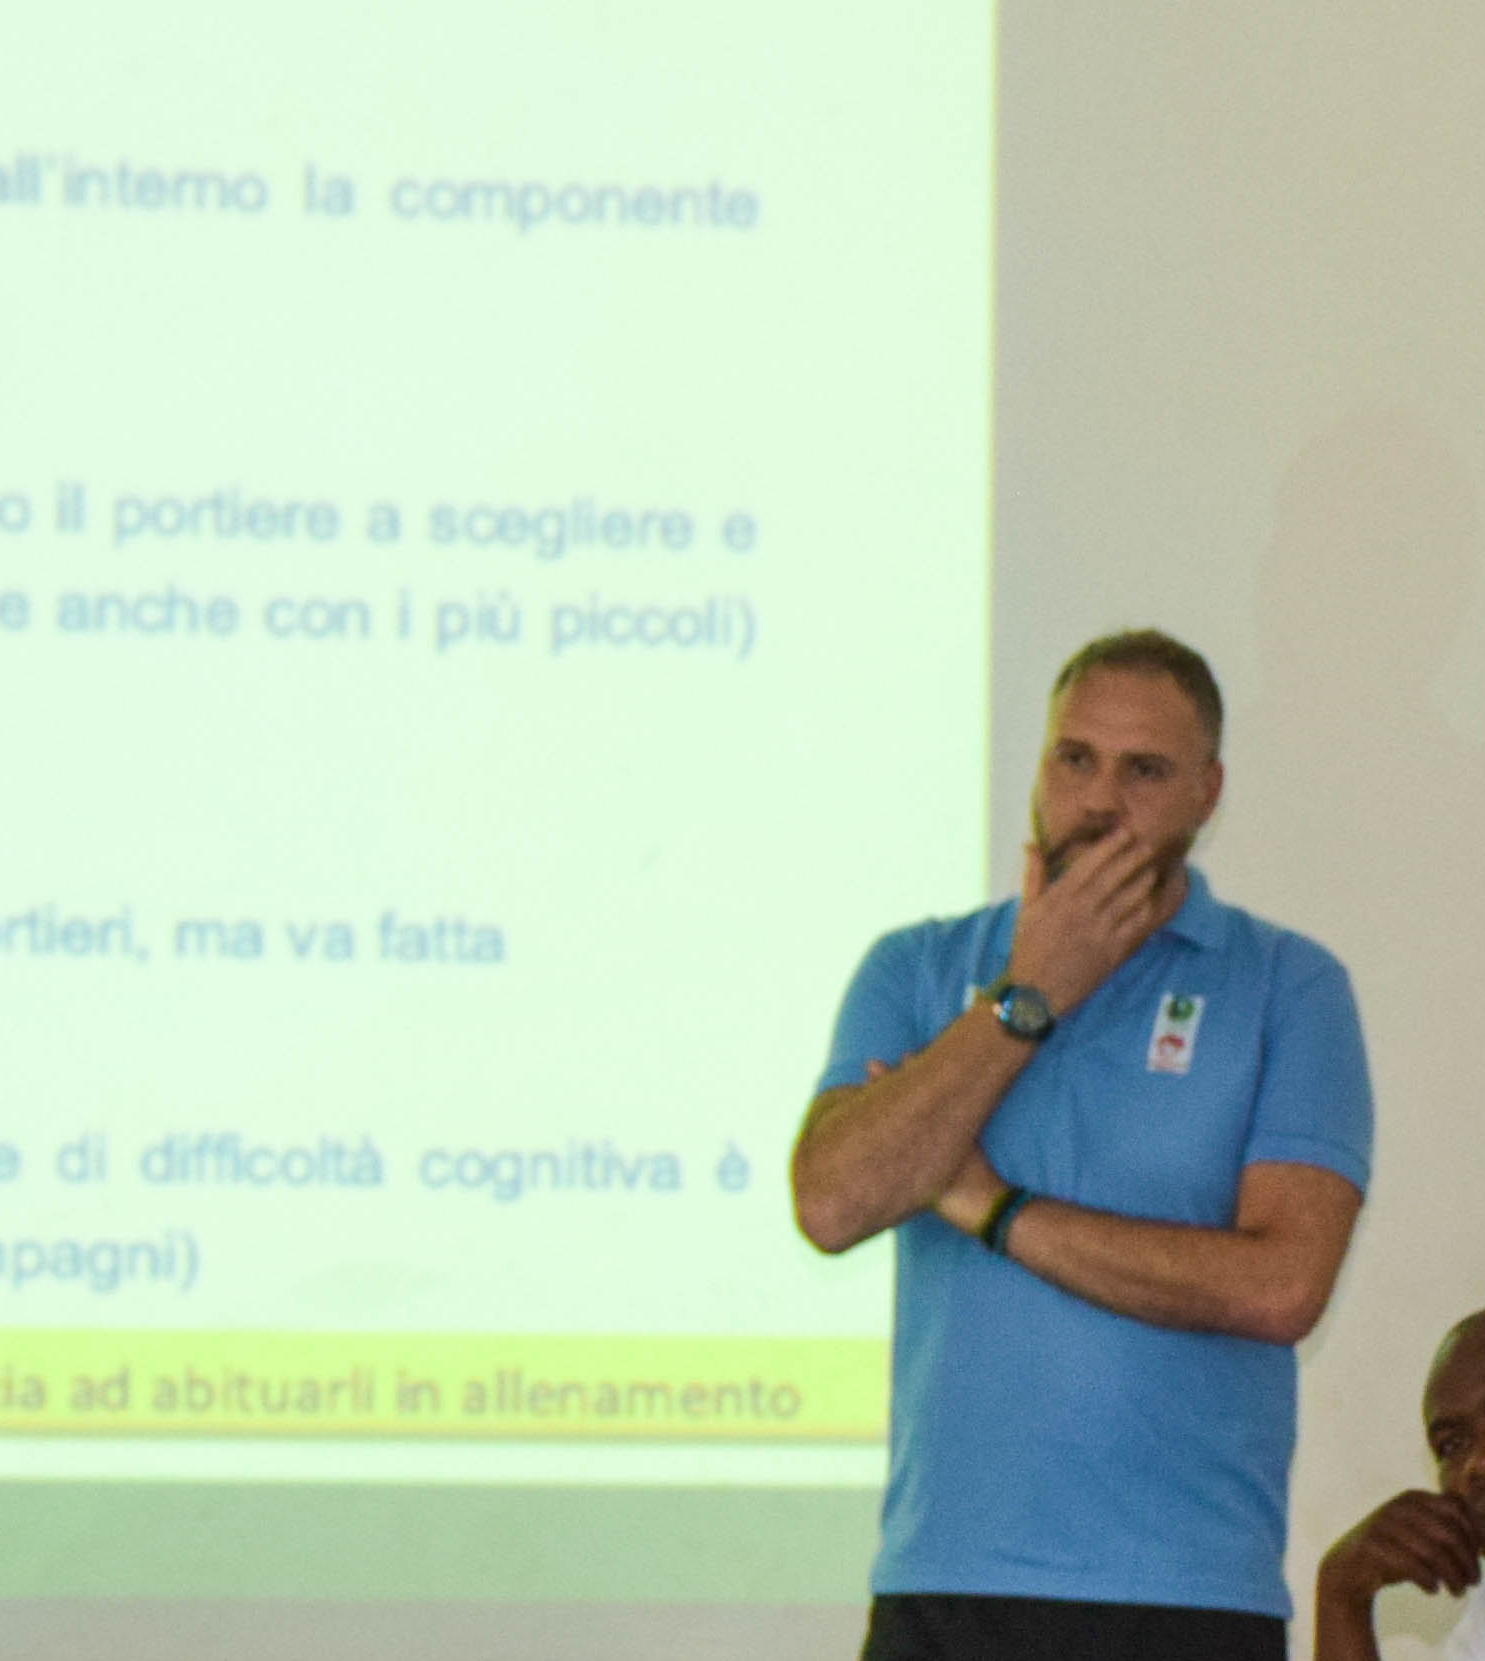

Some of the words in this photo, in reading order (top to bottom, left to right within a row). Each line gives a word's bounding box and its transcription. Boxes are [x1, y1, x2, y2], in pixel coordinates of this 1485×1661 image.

[299, 162, 358, 220] la
[388, 177, 761, 237] componente
[54, 479, 88, 535] il
[111, 486, 344, 549] portiere
[363, 500, 404, 547] a
[426, 497, 697, 564] scegliere
[719, 512, 758, 555] e
[53, 582, 242, 641] anche
[261, 596, 374, 642] con
[394, 588, 414, 642] i
[548, 591, 757, 662] piccoli)
[169, 917, 267, 964] ma
[283, 920, 360, 965] va
[373, 907, 508, 967] fatta
[53, 1131, 109, 1187] di
[135, 1130, 387, 1190] difficoltà
[416, 1139, 684, 1206] cognitiva
[713, 1141, 752, 1195] è
[70, 1364, 131, 1412] ad
[152, 1364, 373, 1414] abituarli
[395, 1364, 441, 1414] in
[461, 1366, 803, 1420] allenamento
